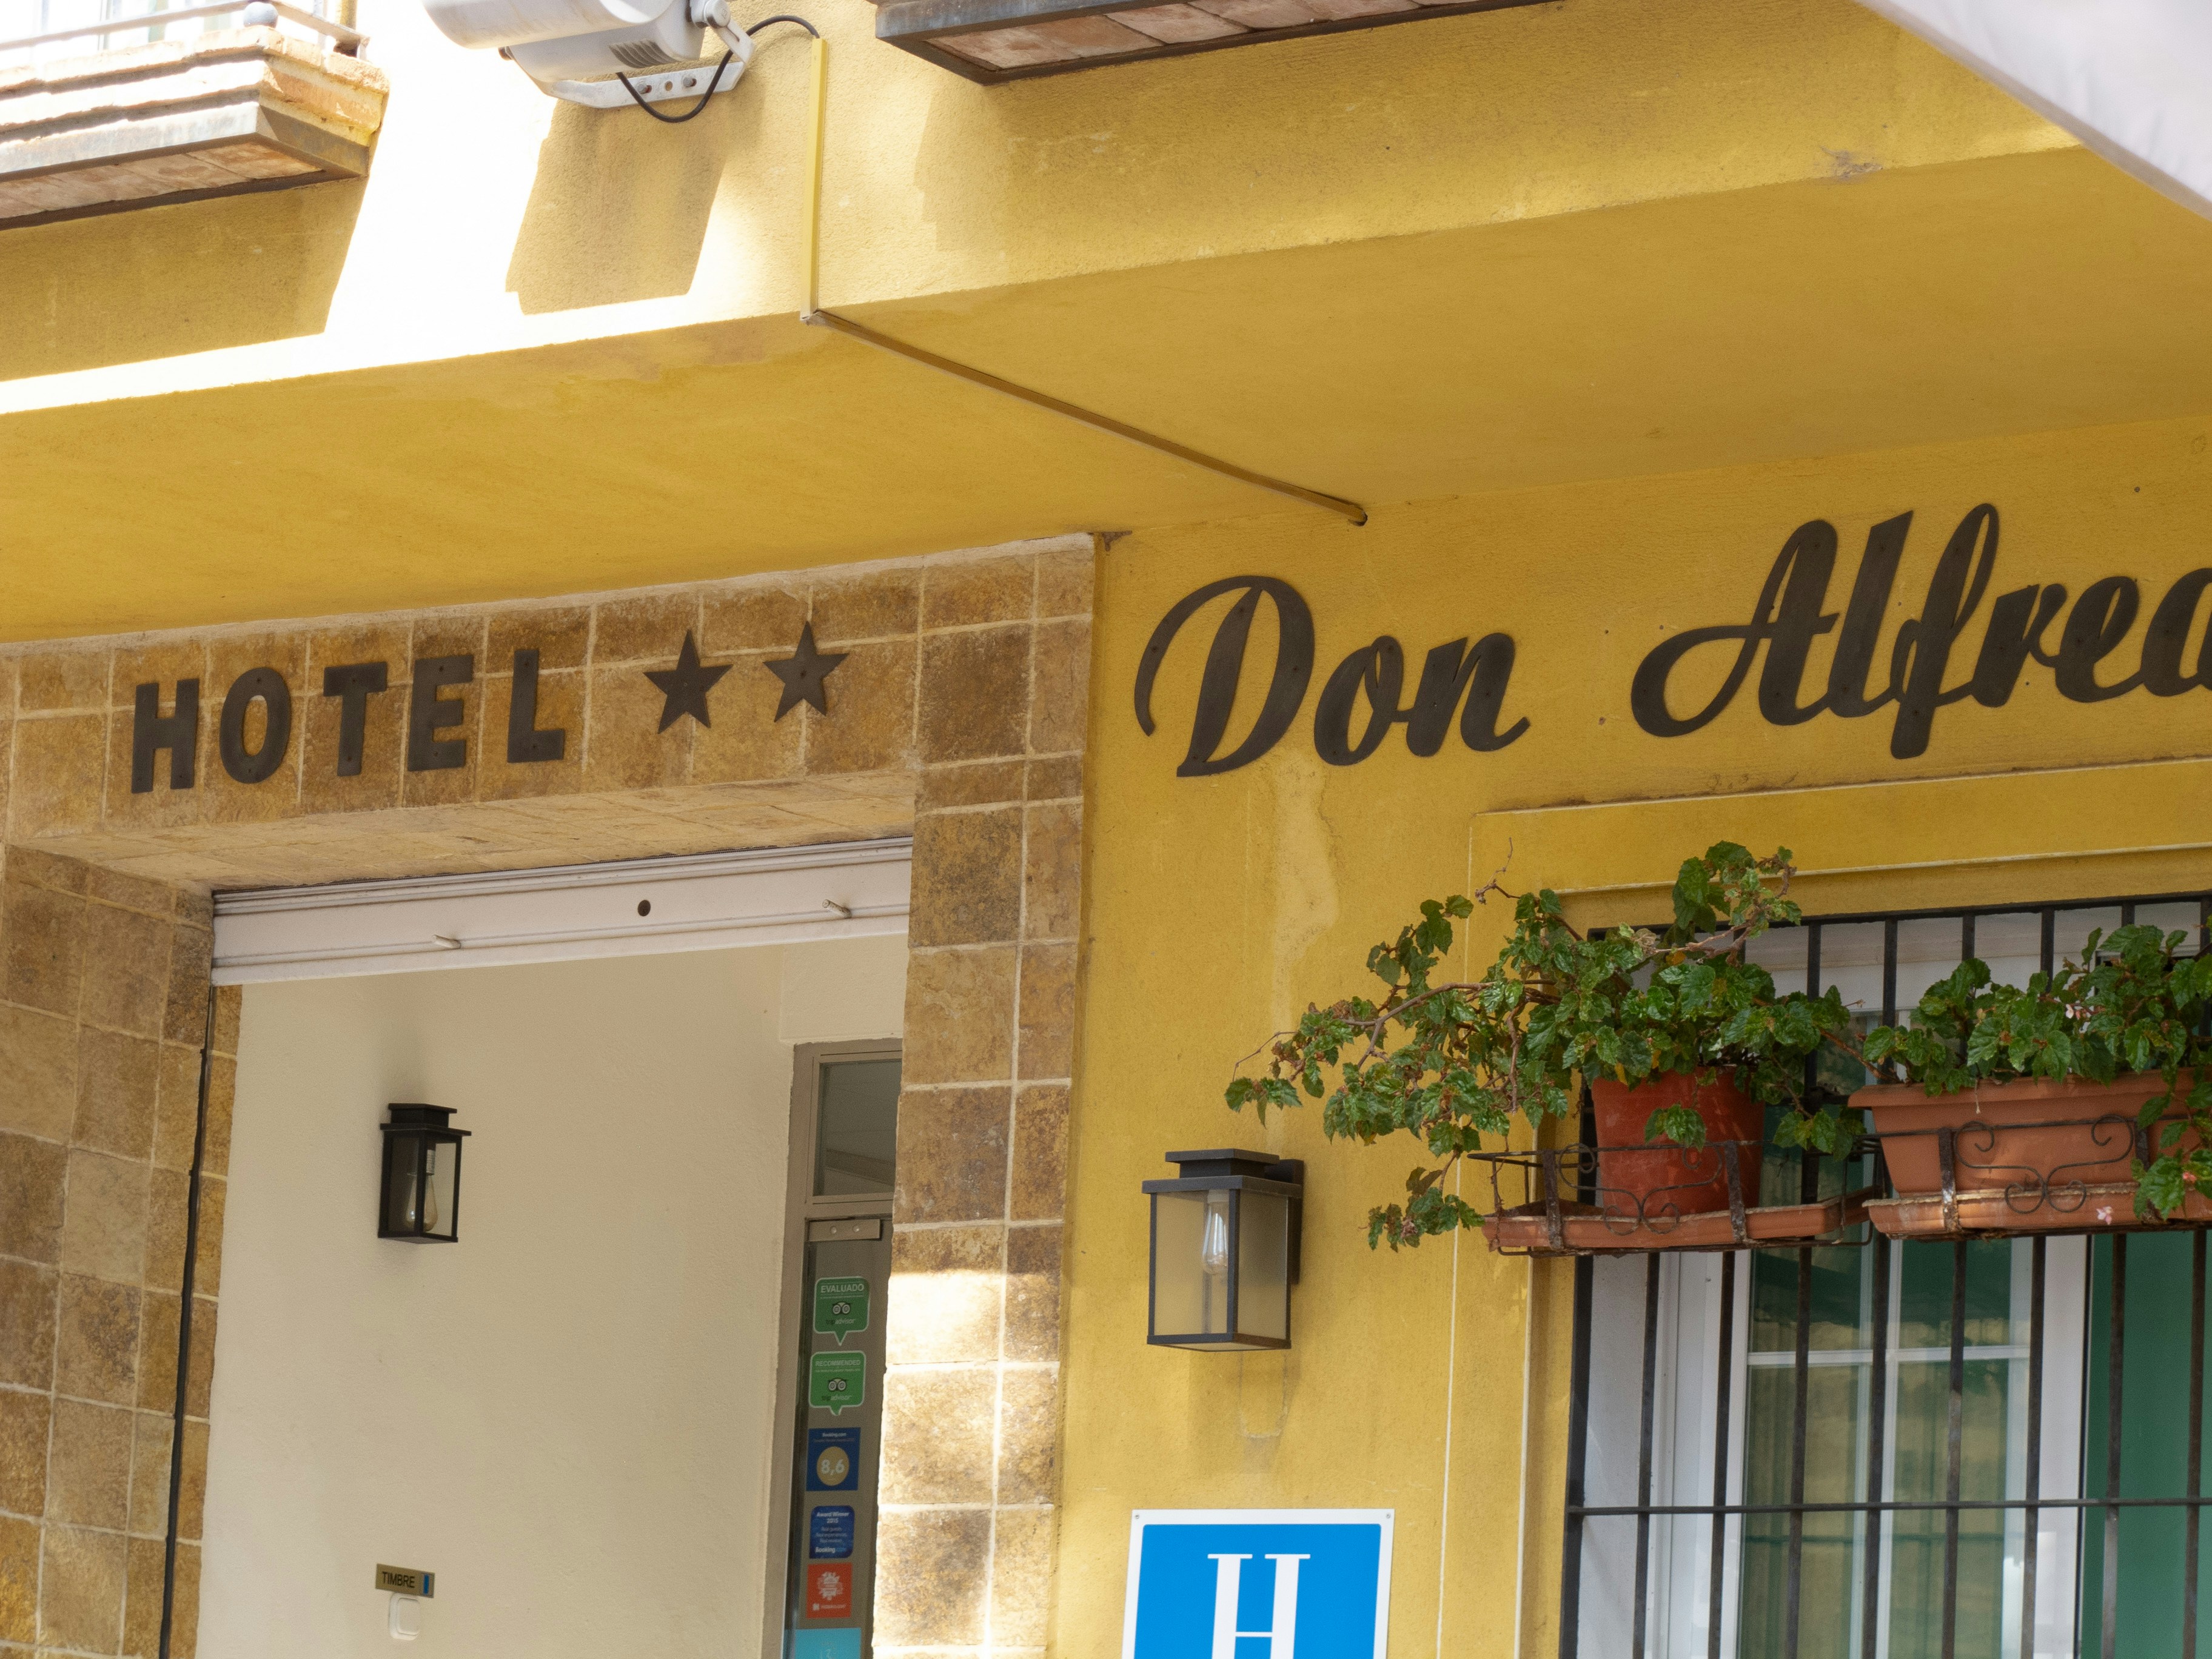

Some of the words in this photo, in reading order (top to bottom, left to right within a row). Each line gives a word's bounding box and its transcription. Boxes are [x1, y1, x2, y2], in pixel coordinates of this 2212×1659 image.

[1134, 575, 1529, 777] Don
[131, 648, 565, 794] HOTEL
[820, 1284, 865, 1293] EVALUADO
[821, 1459, 845, 1475] 8,6
[382, 1571, 415, 1588] TIMBRE
[1207, 1553, 1311, 1659] H
